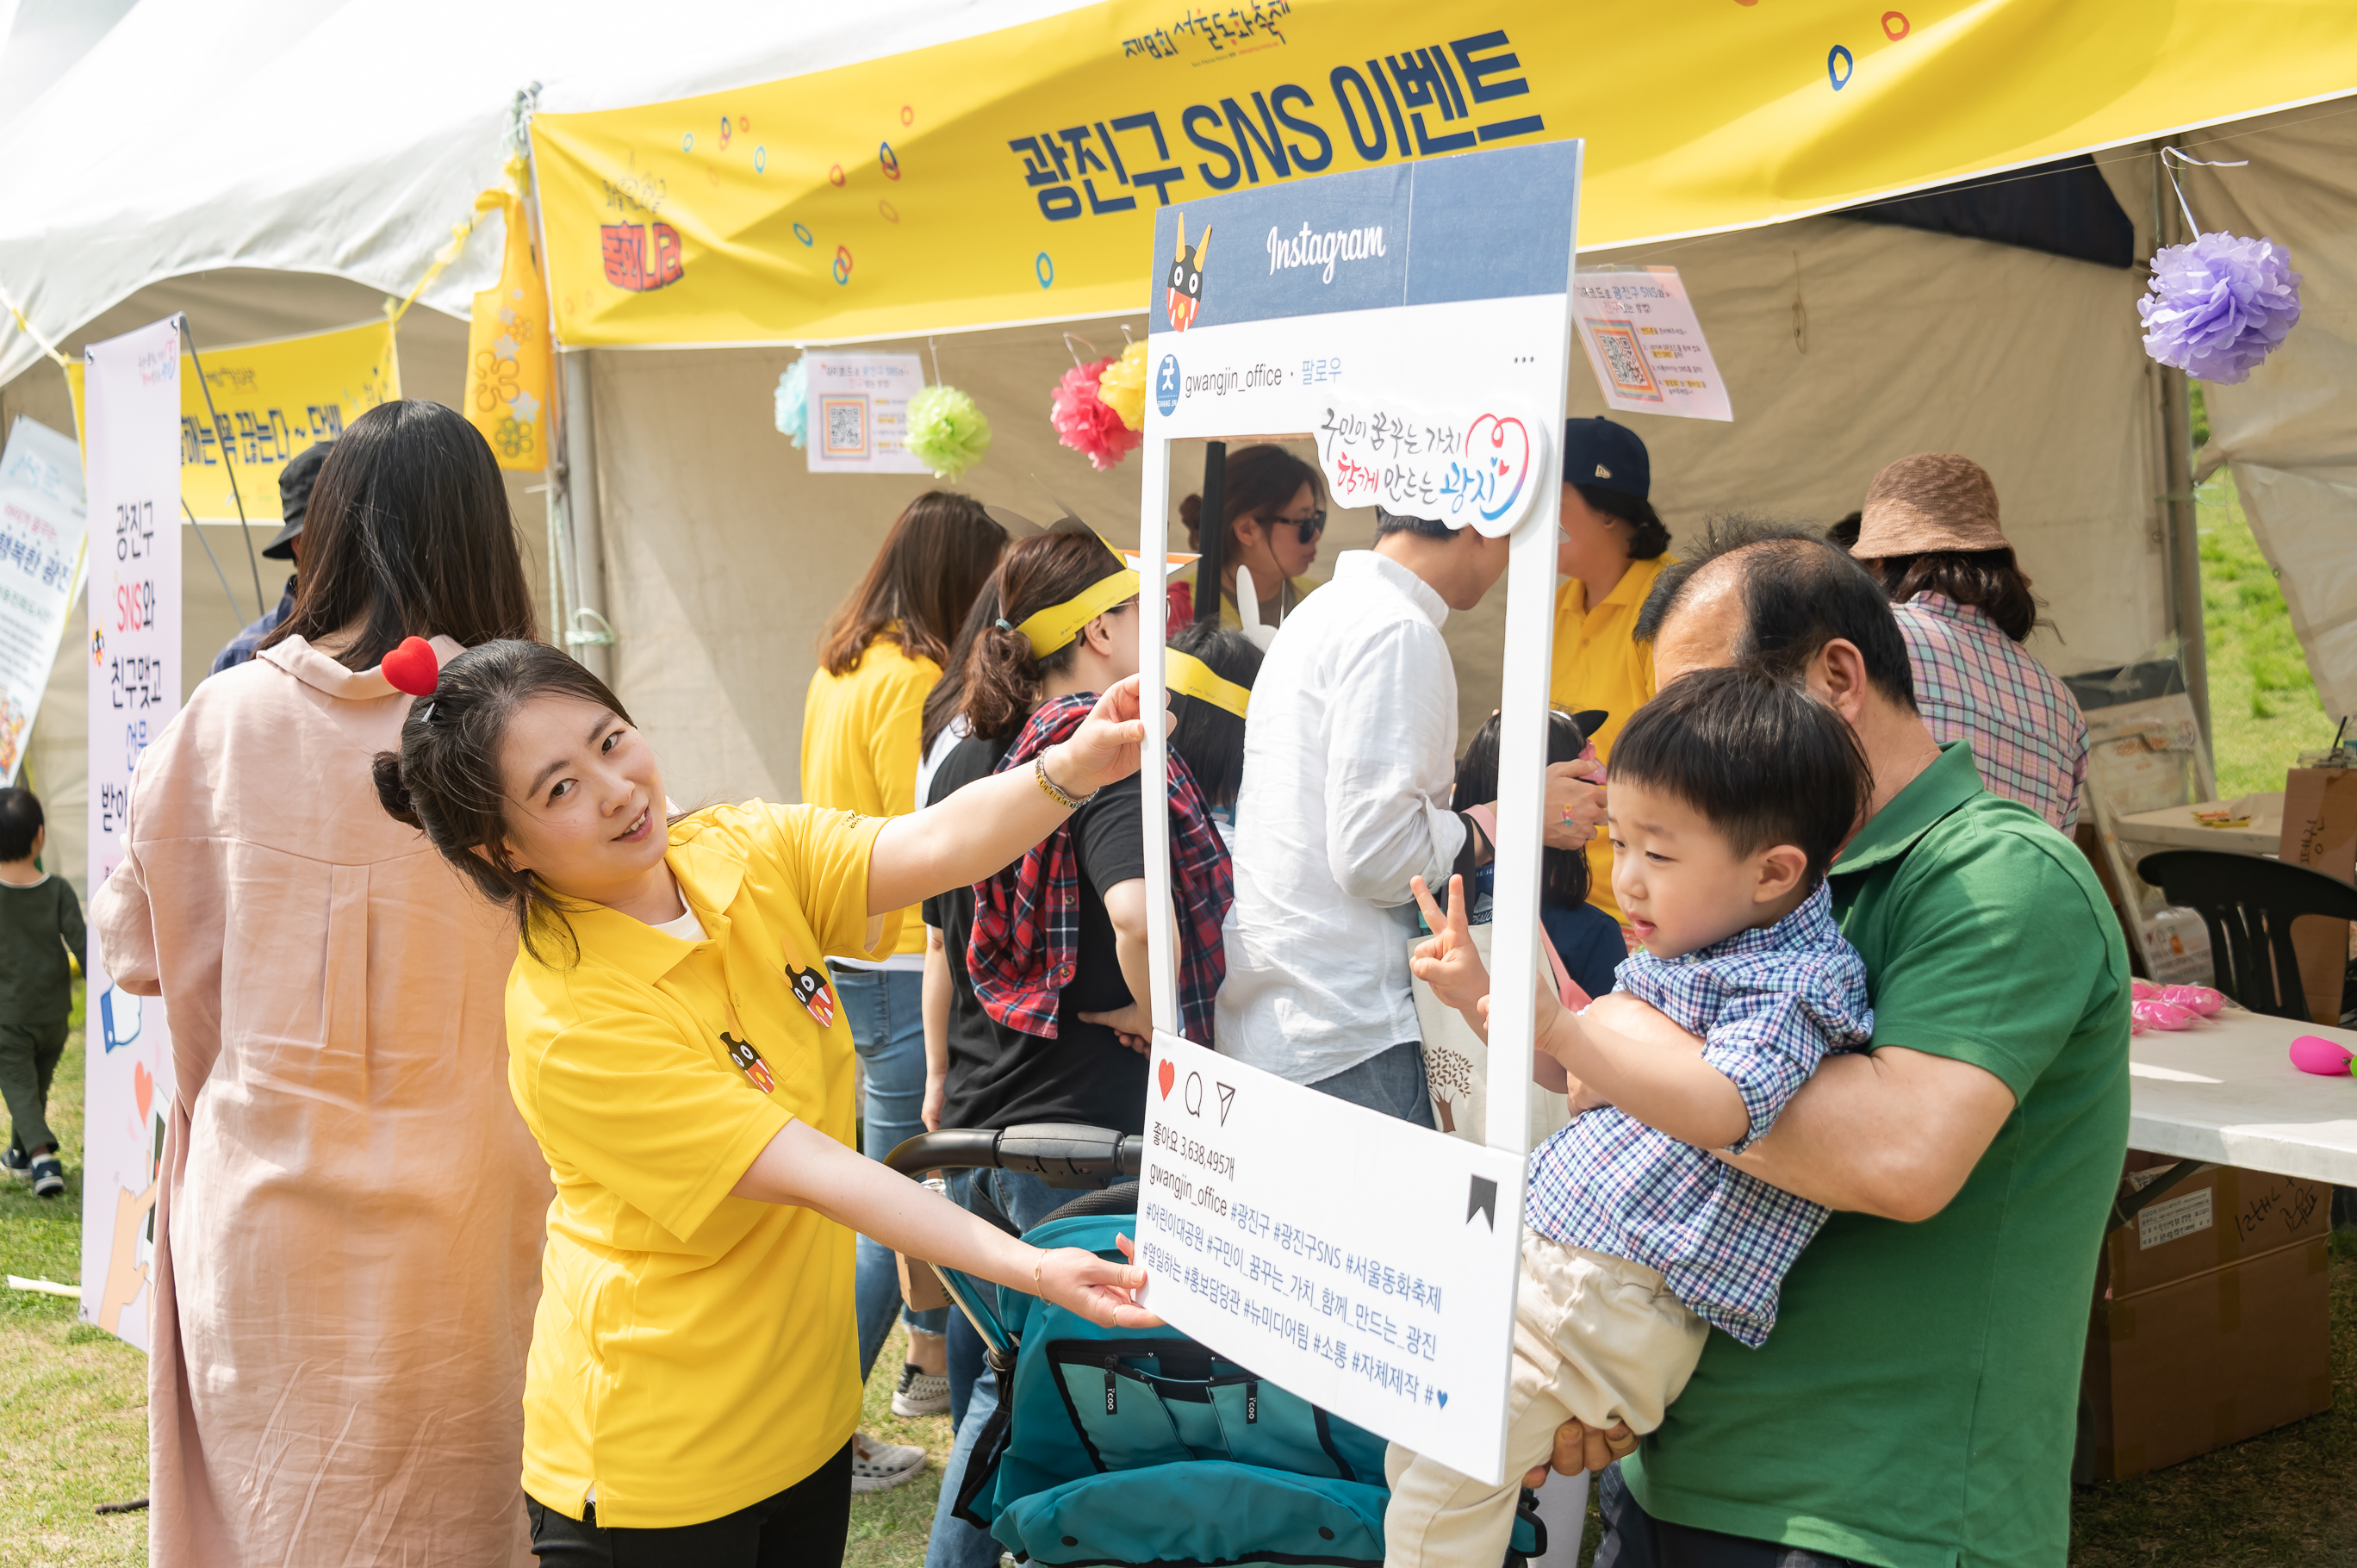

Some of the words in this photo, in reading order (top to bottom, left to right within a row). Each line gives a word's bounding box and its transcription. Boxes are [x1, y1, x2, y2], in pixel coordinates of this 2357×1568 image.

[1008, 110, 1185, 221] 광진구
[1181, 84, 1333, 190] SNS
[1329, 29, 1545, 162] 이벤트
[1266, 221, 1386, 285] Instagram
[1612, 286, 1639, 300] 광진구
[1639, 286, 1665, 299] SNS와
[1185, 364, 1282, 398] gwangjin_office
[1302, 357, 1342, 386] 팔로우
[181, 414, 216, 466] 해는
[235, 408, 290, 464] 끊는다
[1321, 408, 1367, 463] 구민이
[1371, 411, 1421, 460] 꿈꾸는
[1426, 426, 1461, 455] 가치
[1337, 451, 1379, 495] 함께
[1384, 464, 1438, 506] 만드는
[116, 500, 154, 562] 광진구
[117, 579, 155, 632] SNS와
[111, 655, 162, 710] 친구맺고
[1154, 1121, 1178, 1153] 좋아요
[1180, 1136, 1235, 1182] 3,638,495개
[1146, 1201, 1204, 1253] #어린이대공원
[1149, 1163, 1228, 1216] gwangjin_office
[1230, 1202, 1270, 1239] #광진구
[1273, 1221, 1341, 1269] #광진구SNS
[1346, 1252, 1442, 1314] #서울동화축제
[1142, 1241, 1182, 1284] #열일하는
[1184, 1265, 1241, 1316] #홍보담당관
[1243, 1297, 1309, 1352] #뉴미디어팀
[1313, 1332, 1348, 1370] #소통
[1352, 1350, 1420, 1403] #자체제작
[1248, 1397, 1257, 1420] i'coo
